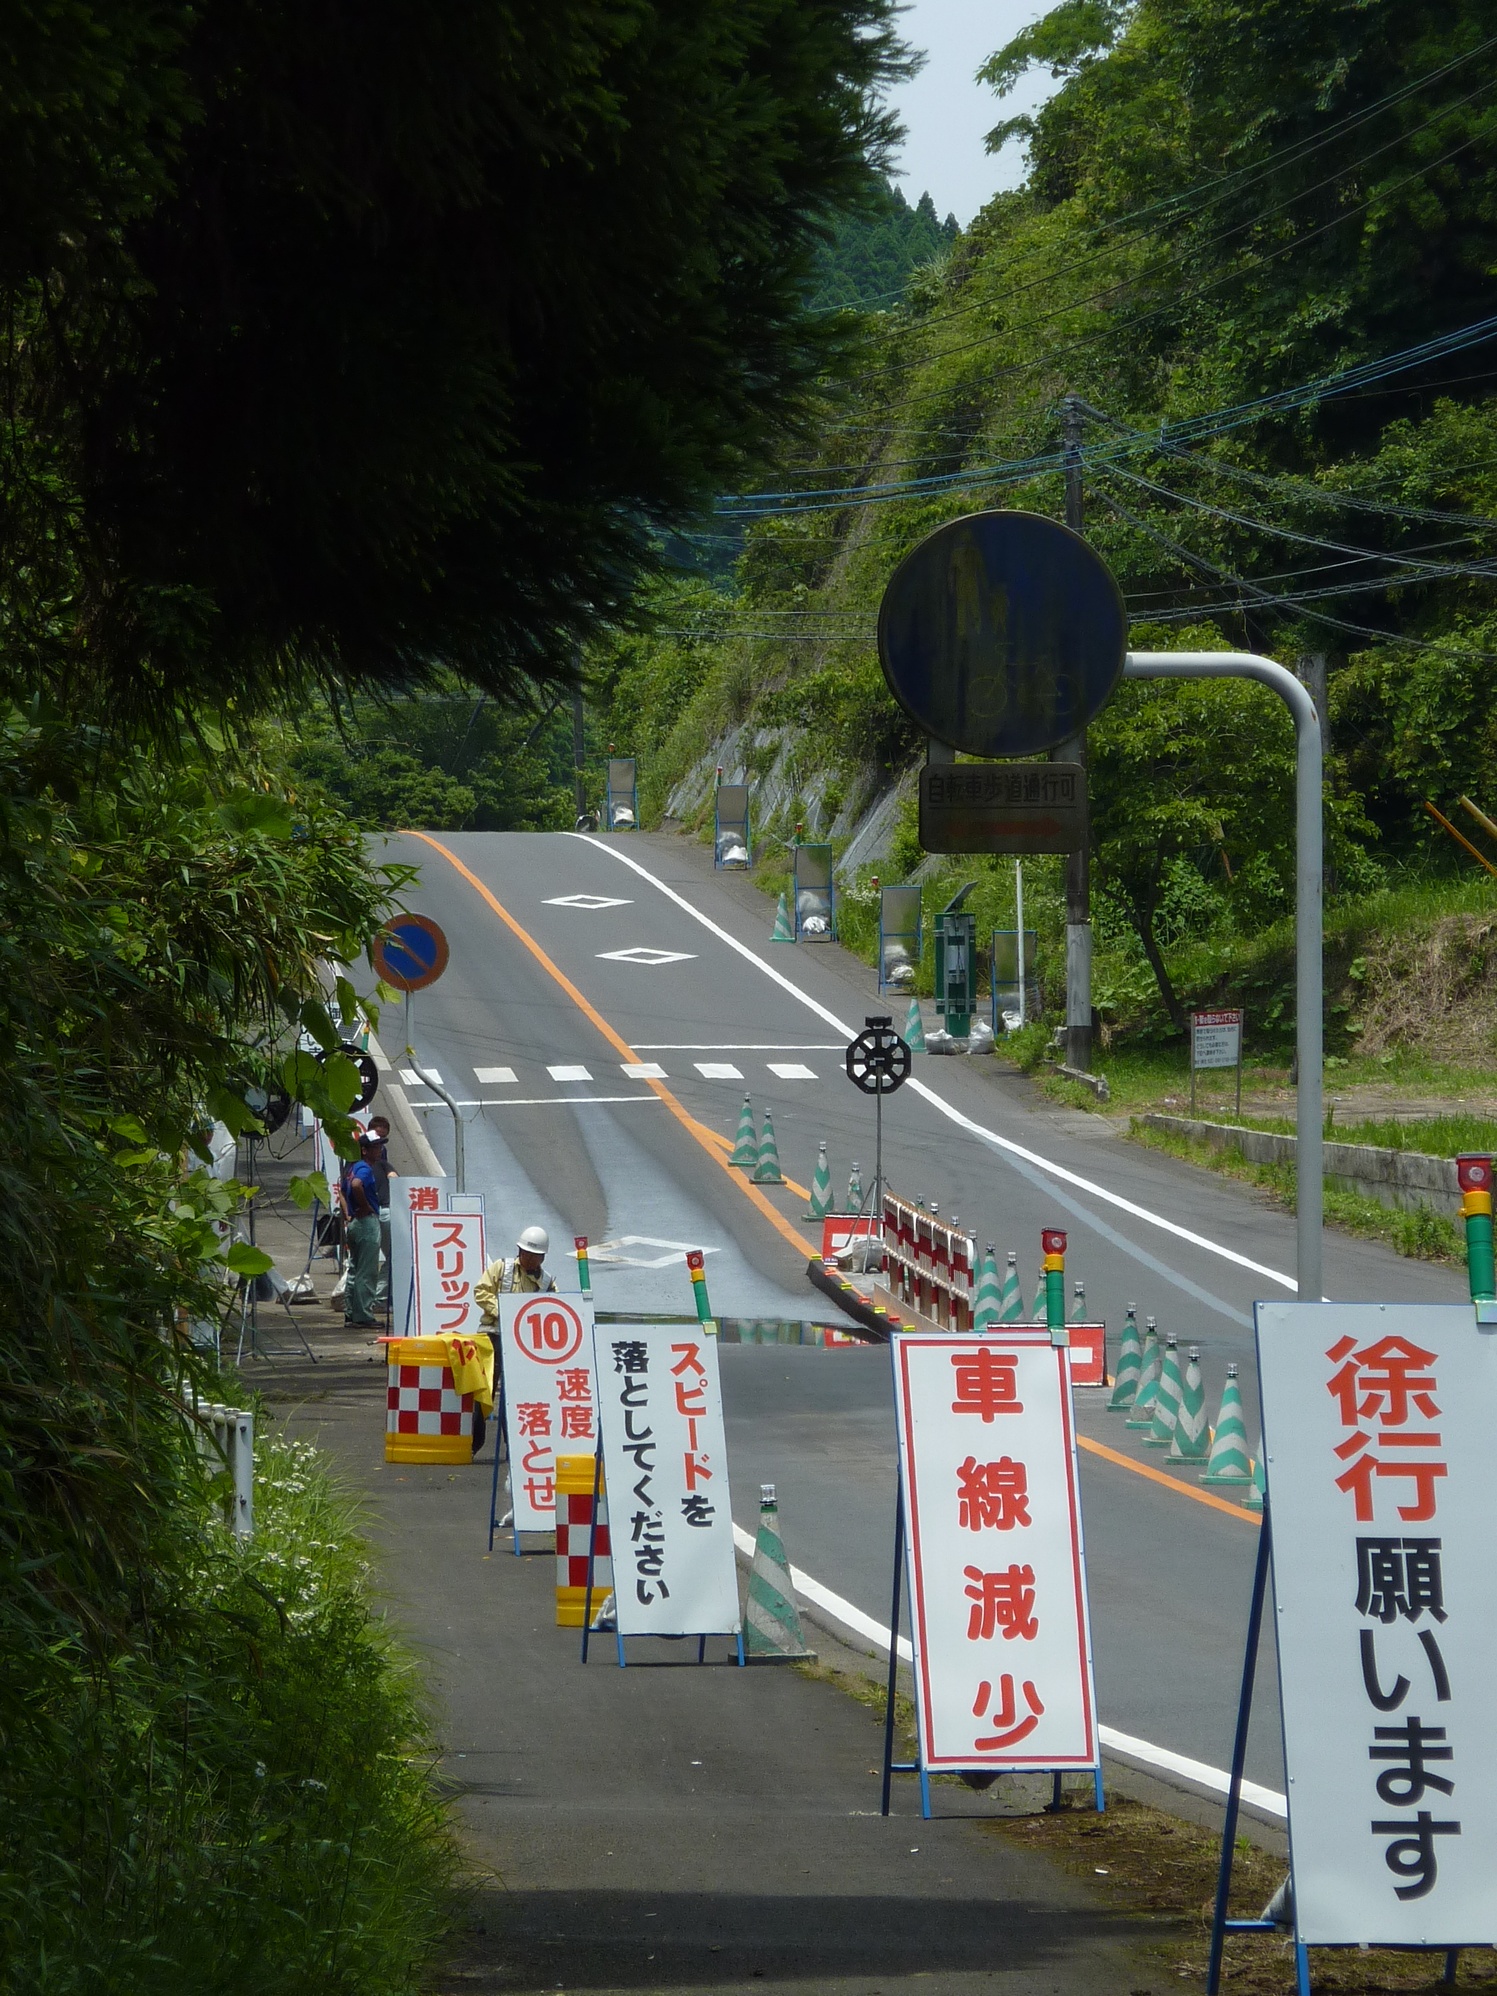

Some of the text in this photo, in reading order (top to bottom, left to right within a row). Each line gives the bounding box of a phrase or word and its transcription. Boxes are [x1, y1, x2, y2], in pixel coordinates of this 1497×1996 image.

[409, 1187, 439, 1211] 消
[432, 1222, 470, 1335] スリップ
[527, 1313, 569, 1350] 10
[516, 1402, 556, 1511] 落とせ
[555, 1368, 596, 1440] 速度
[670, 1342, 716, 1528] スピードを
[611, 1341, 670, 1606] 落としてください
[950, 1346, 1045, 1752] 車線減少
[1325, 1334, 1461, 1901] 徐行願います
